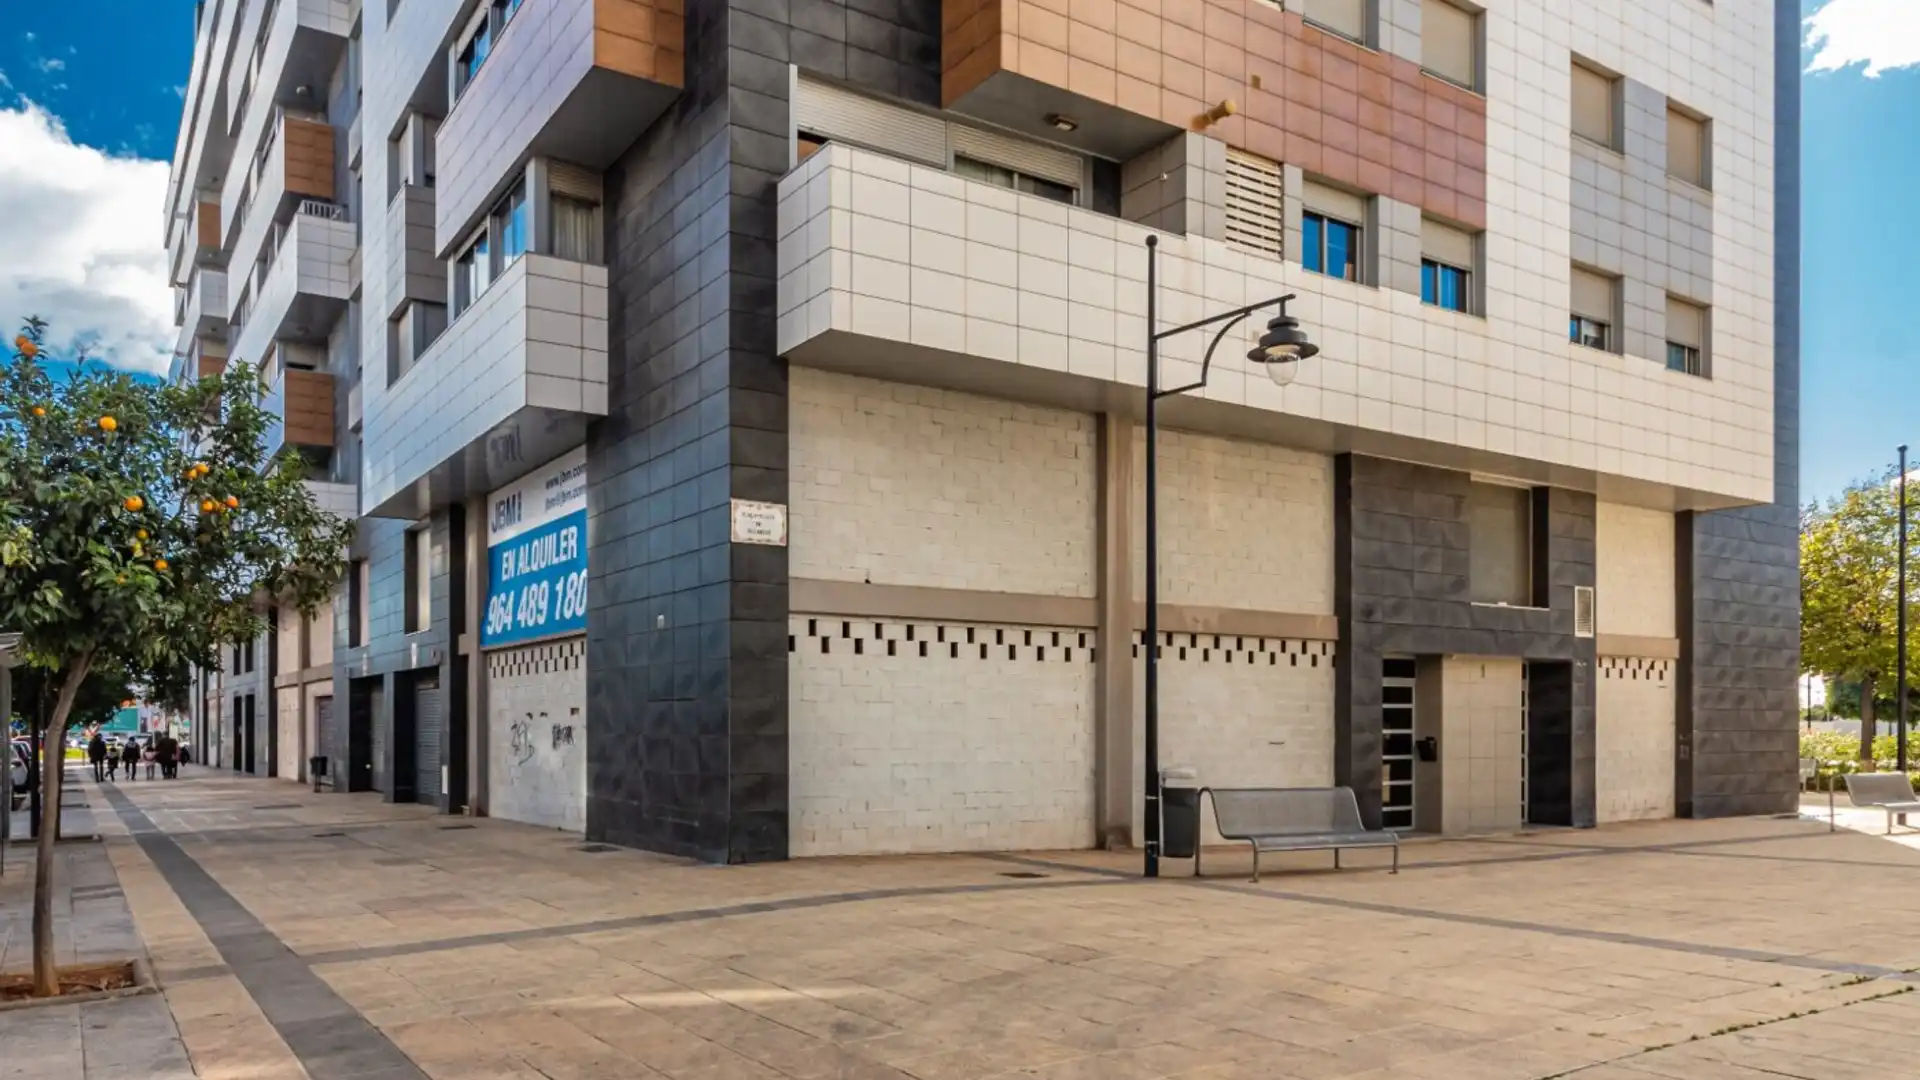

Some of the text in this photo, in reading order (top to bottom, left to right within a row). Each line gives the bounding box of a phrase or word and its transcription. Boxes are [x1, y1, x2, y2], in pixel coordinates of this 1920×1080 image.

[502, 525, 577, 581] EN ALQUILER
[487, 567, 587, 635] 964 489 180
